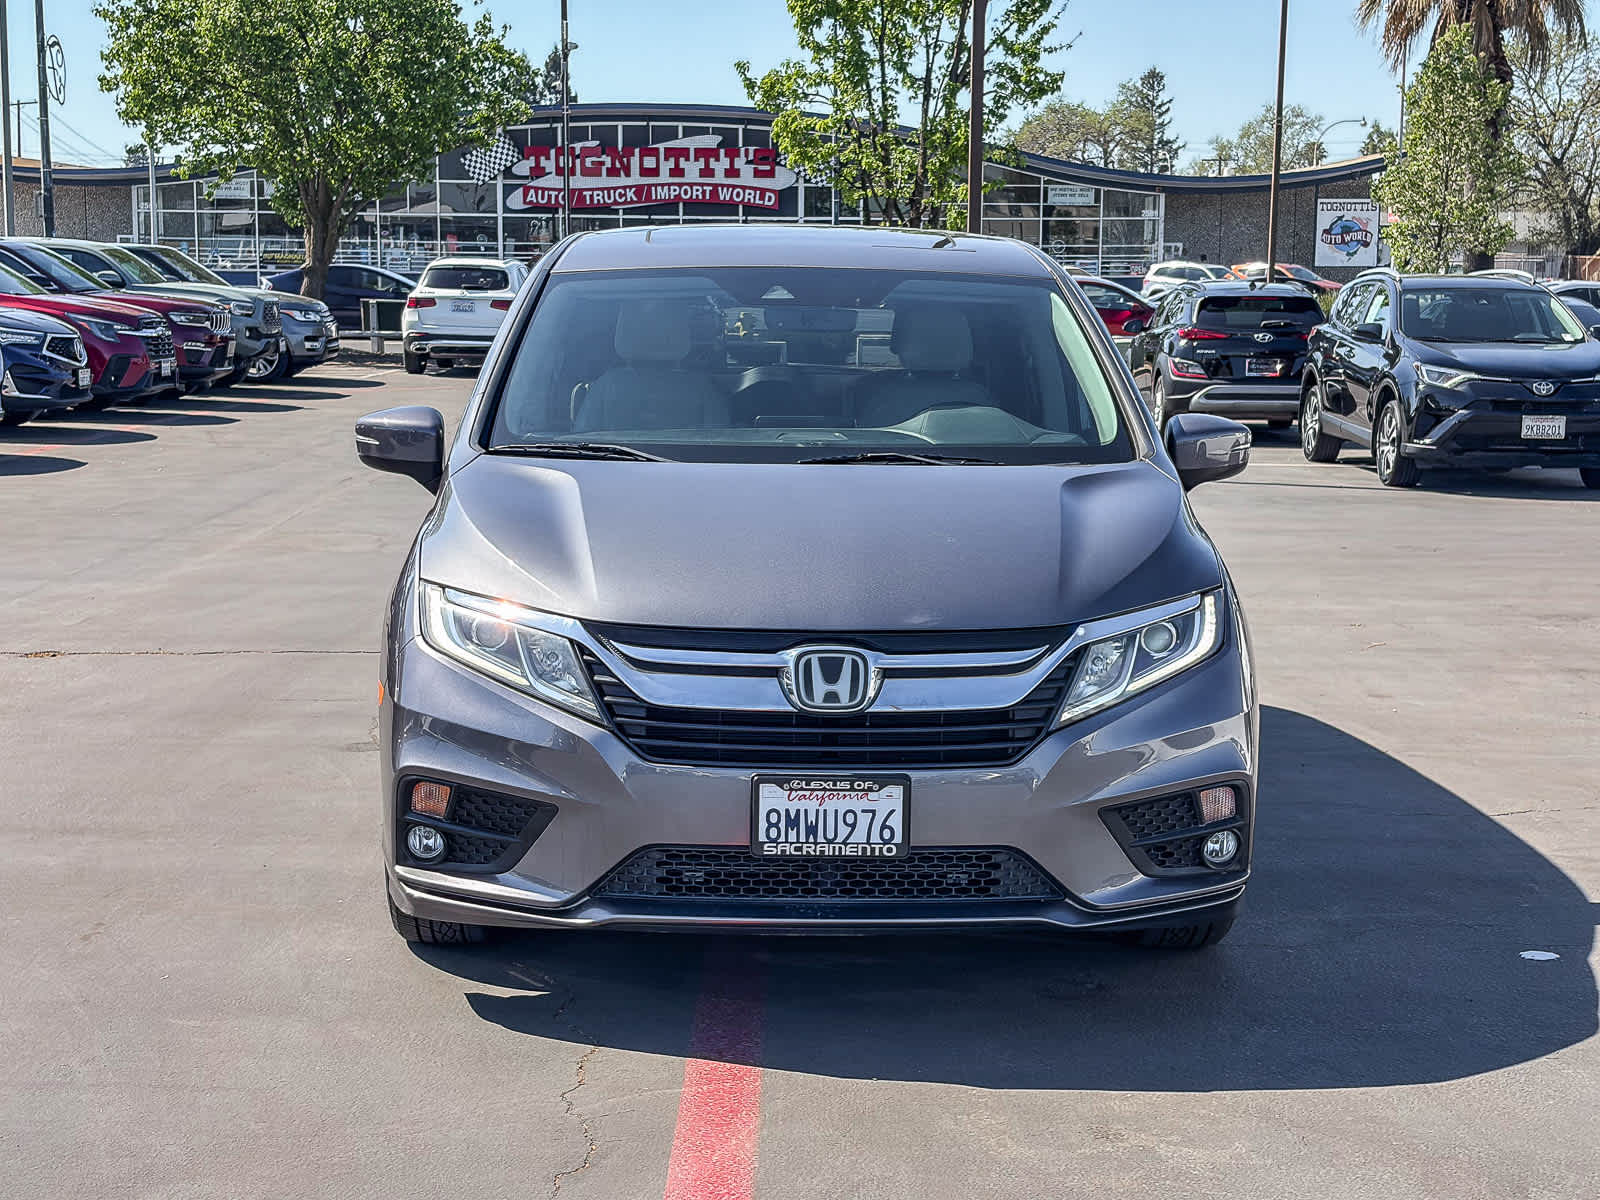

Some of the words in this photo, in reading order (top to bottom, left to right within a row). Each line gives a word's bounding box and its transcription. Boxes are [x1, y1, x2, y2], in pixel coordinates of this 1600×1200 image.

[523, 146, 777, 178] TOGNOTTI'S
[583, 188, 637, 205] TRUCK
[651, 185, 713, 200] IMPORT
[718, 186, 776, 206] WORLD
[1344, 231, 1372, 243] WORLD
[1525, 424, 1561, 435] 9KBB201
[802, 780, 851, 790] LEXUS
[854, 781, 874, 790] OF
[787, 790, 880, 806] California
[765, 808, 897, 843] 8MWU976
[763, 843, 897, 856] SACRAMENTO
